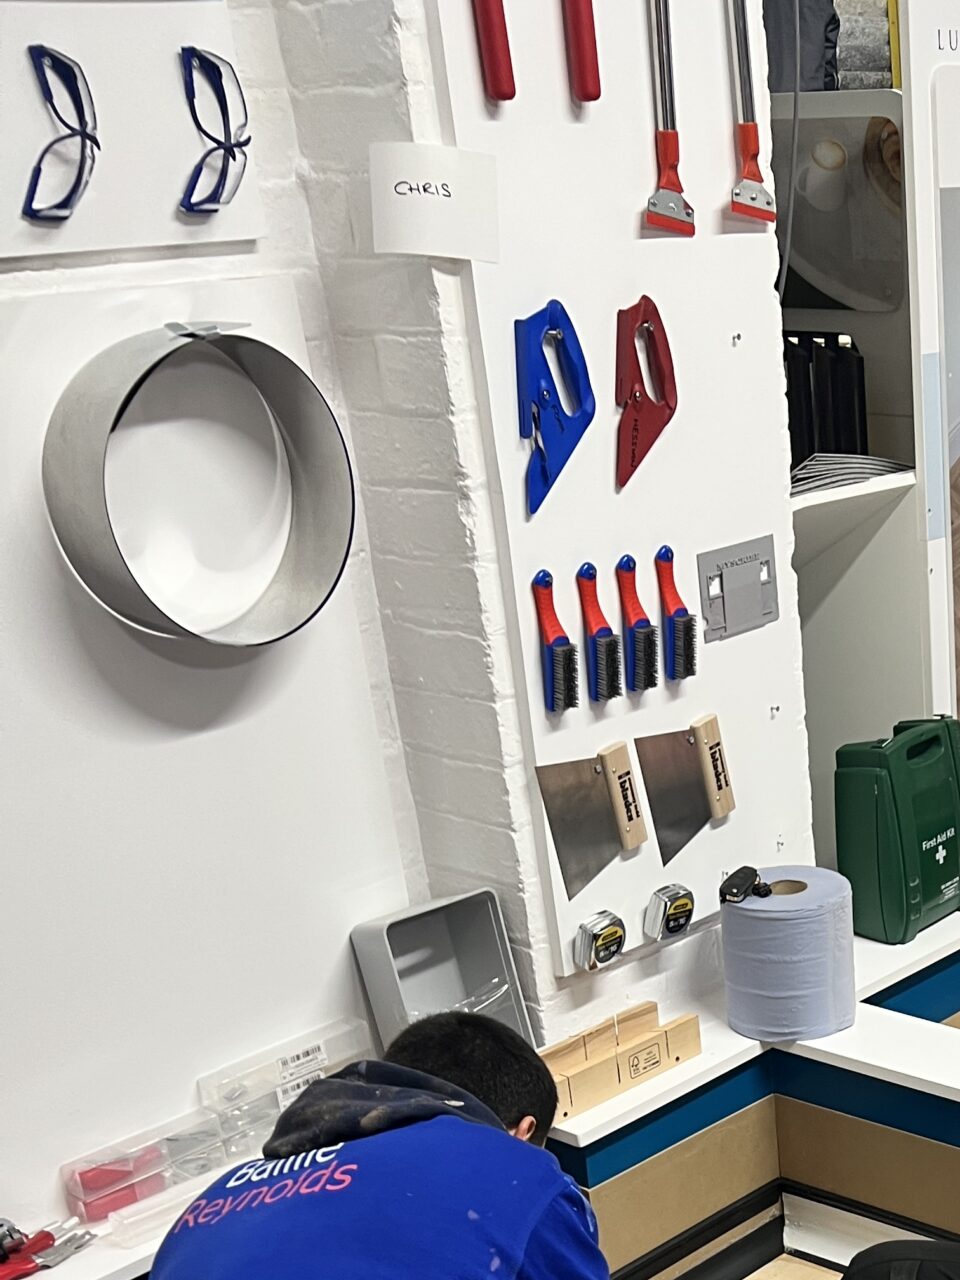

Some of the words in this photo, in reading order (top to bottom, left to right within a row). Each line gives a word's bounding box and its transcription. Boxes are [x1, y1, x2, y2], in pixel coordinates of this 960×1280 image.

[394, 181, 451, 198] CHRIS
[922, 837, 937, 851] First
[937, 831, 947, 844] Aid
[947, 827, 955, 839] Kit
[174, 1160, 358, 1234] Reynolds
